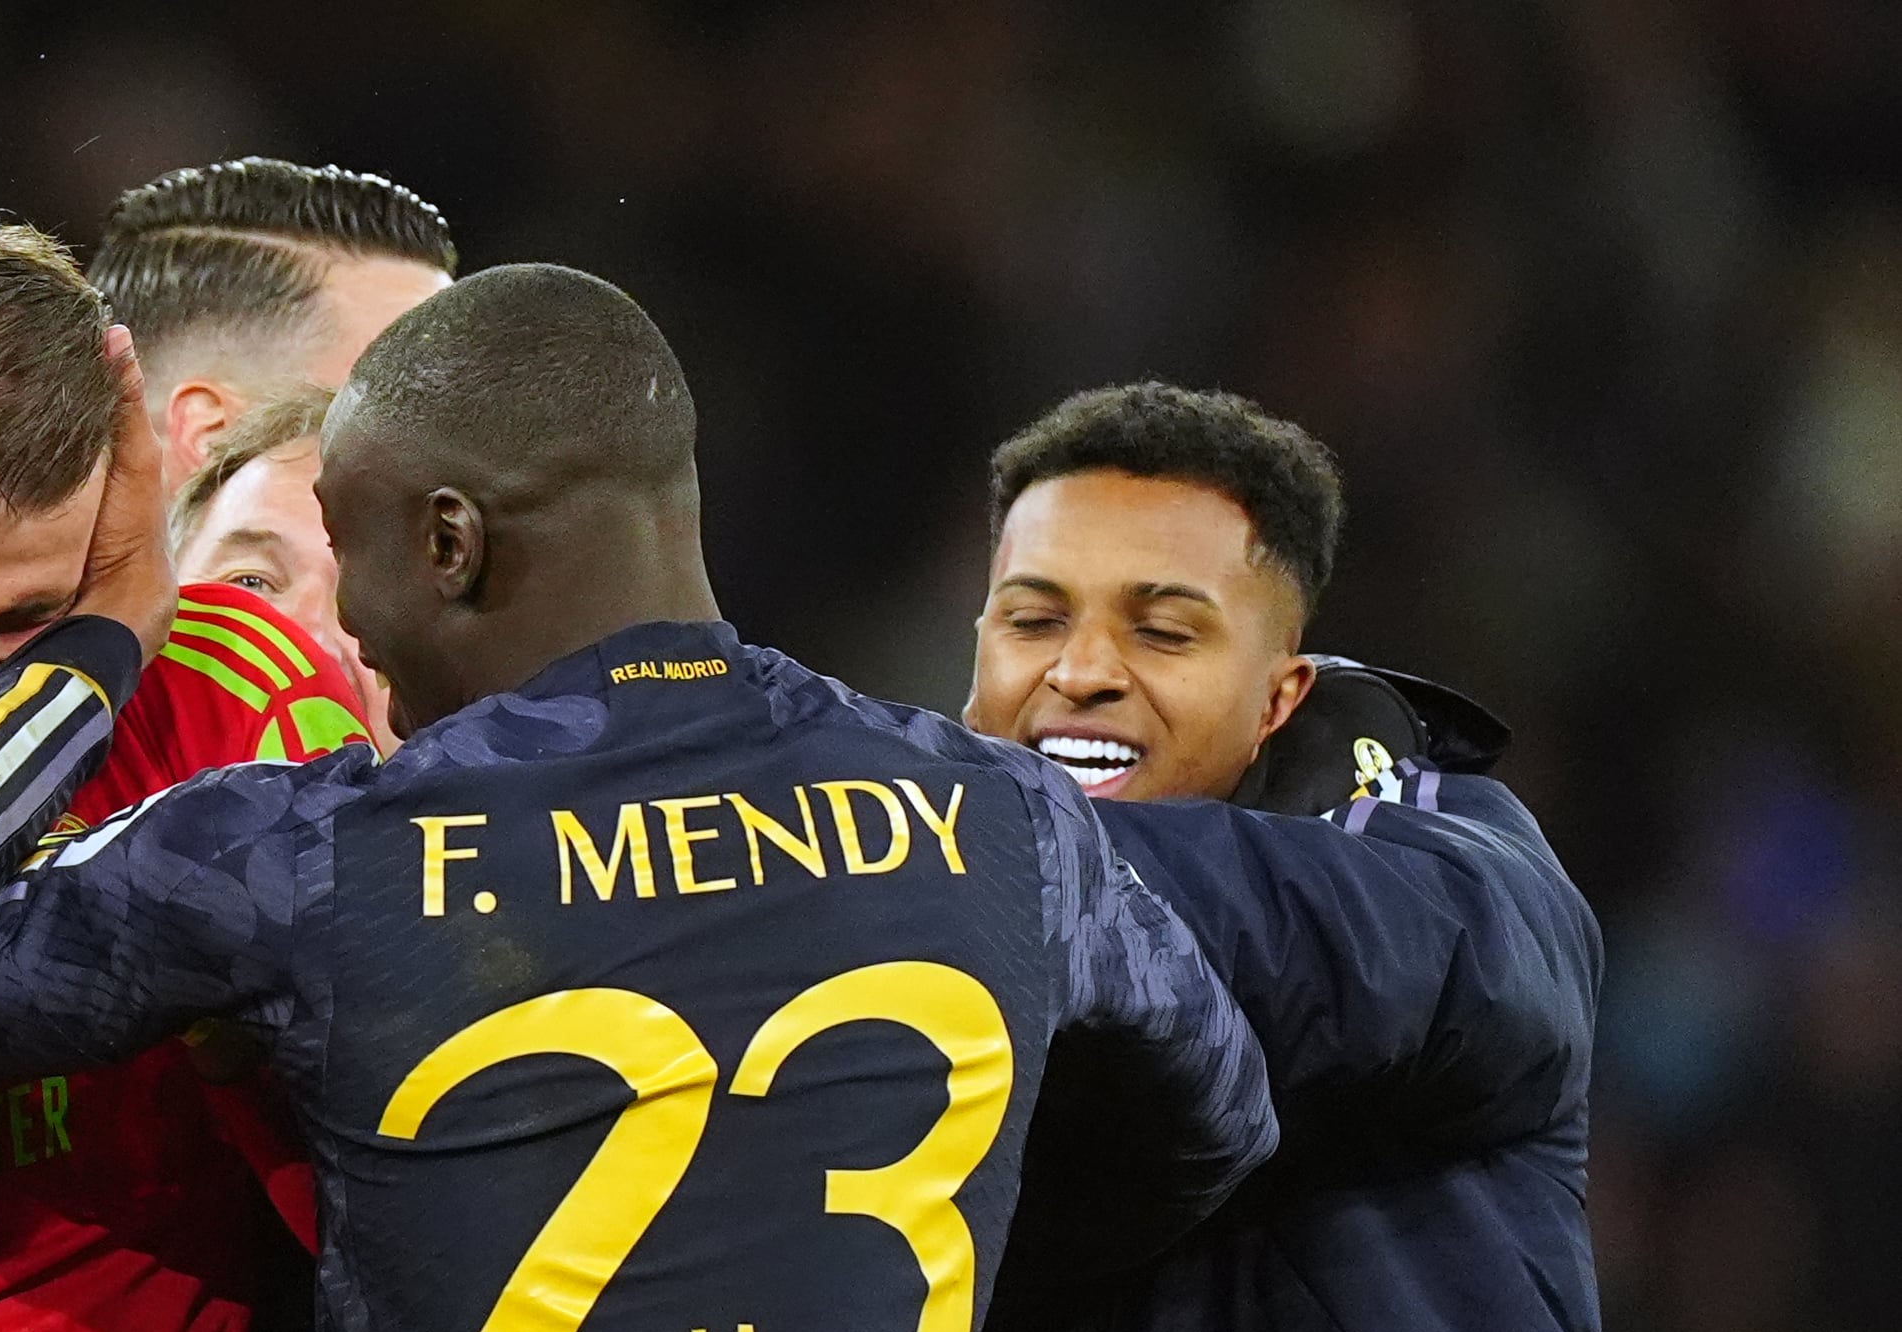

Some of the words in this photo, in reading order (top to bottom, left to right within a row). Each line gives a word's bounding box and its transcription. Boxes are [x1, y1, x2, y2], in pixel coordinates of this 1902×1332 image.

[609, 661, 663, 685] REAL
[663, 658, 728, 681] MADRID
[409, 814, 498, 917] F.
[550, 778, 968, 905] MENDY
